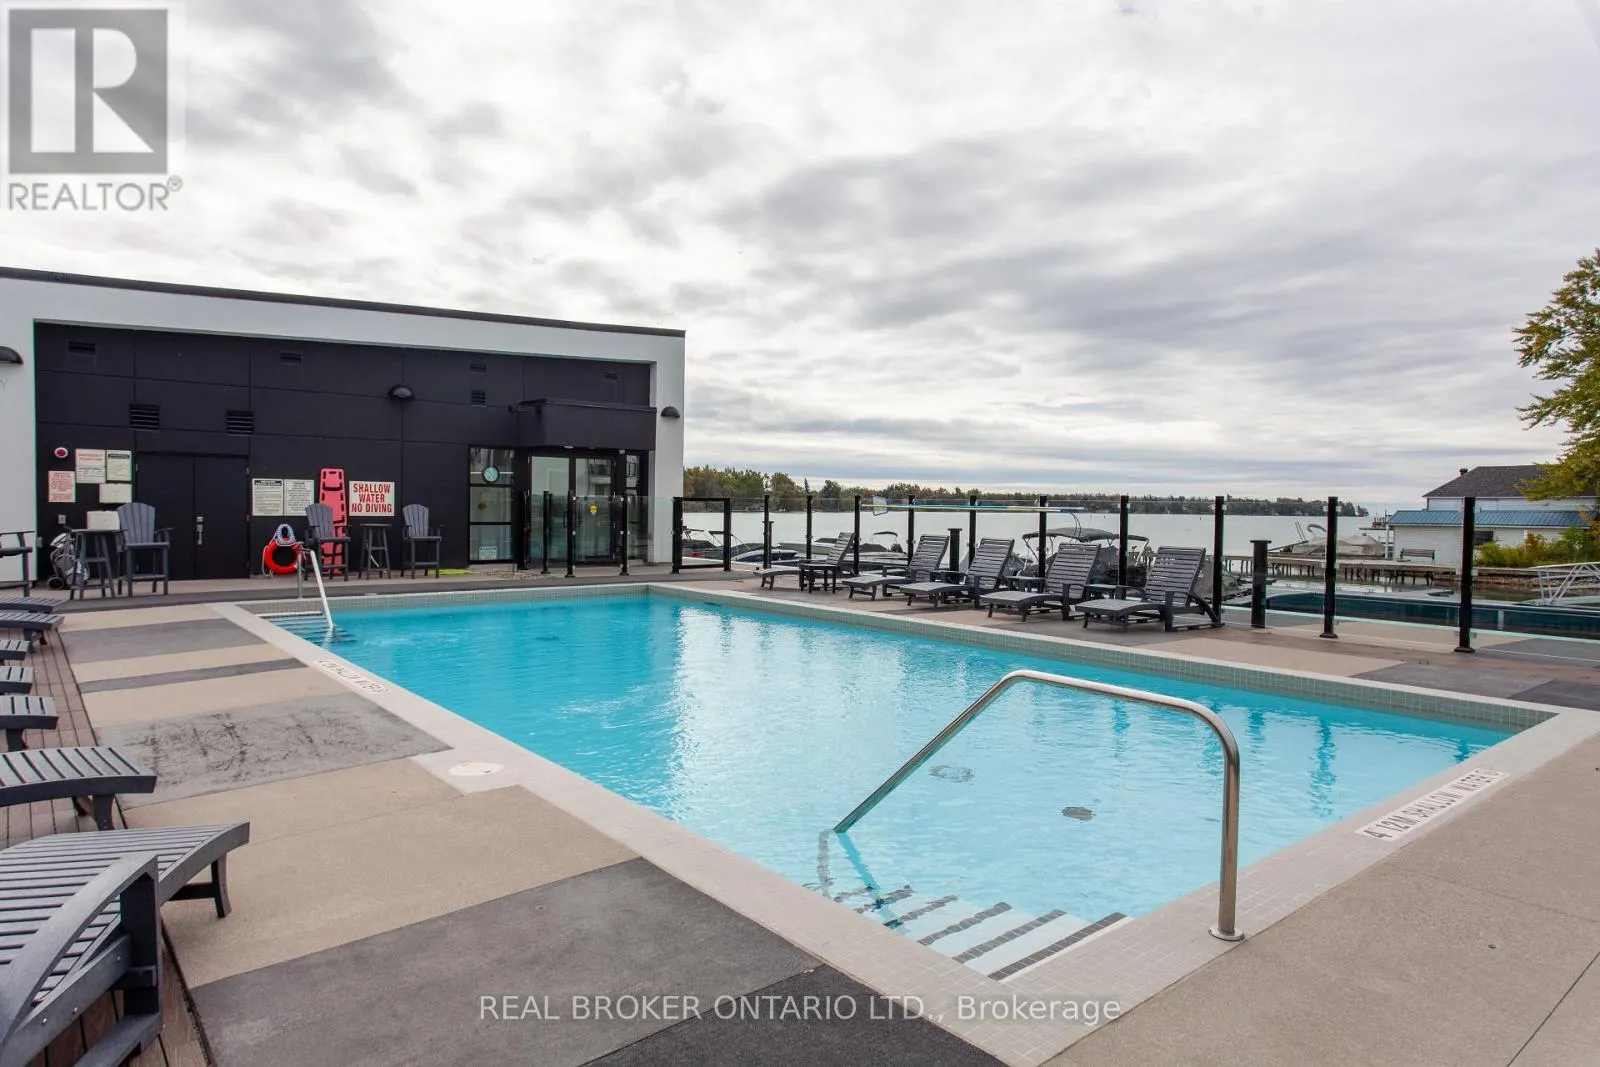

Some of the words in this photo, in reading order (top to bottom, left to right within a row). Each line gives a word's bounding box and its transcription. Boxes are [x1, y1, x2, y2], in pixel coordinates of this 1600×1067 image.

[353, 483, 391, 494] SHALLOW
[359, 493, 385, 503] WATER
[352, 503, 362, 512] NO
[366, 503, 392, 513] DIVING
[1402, 790, 1464, 819] SHALLOW
